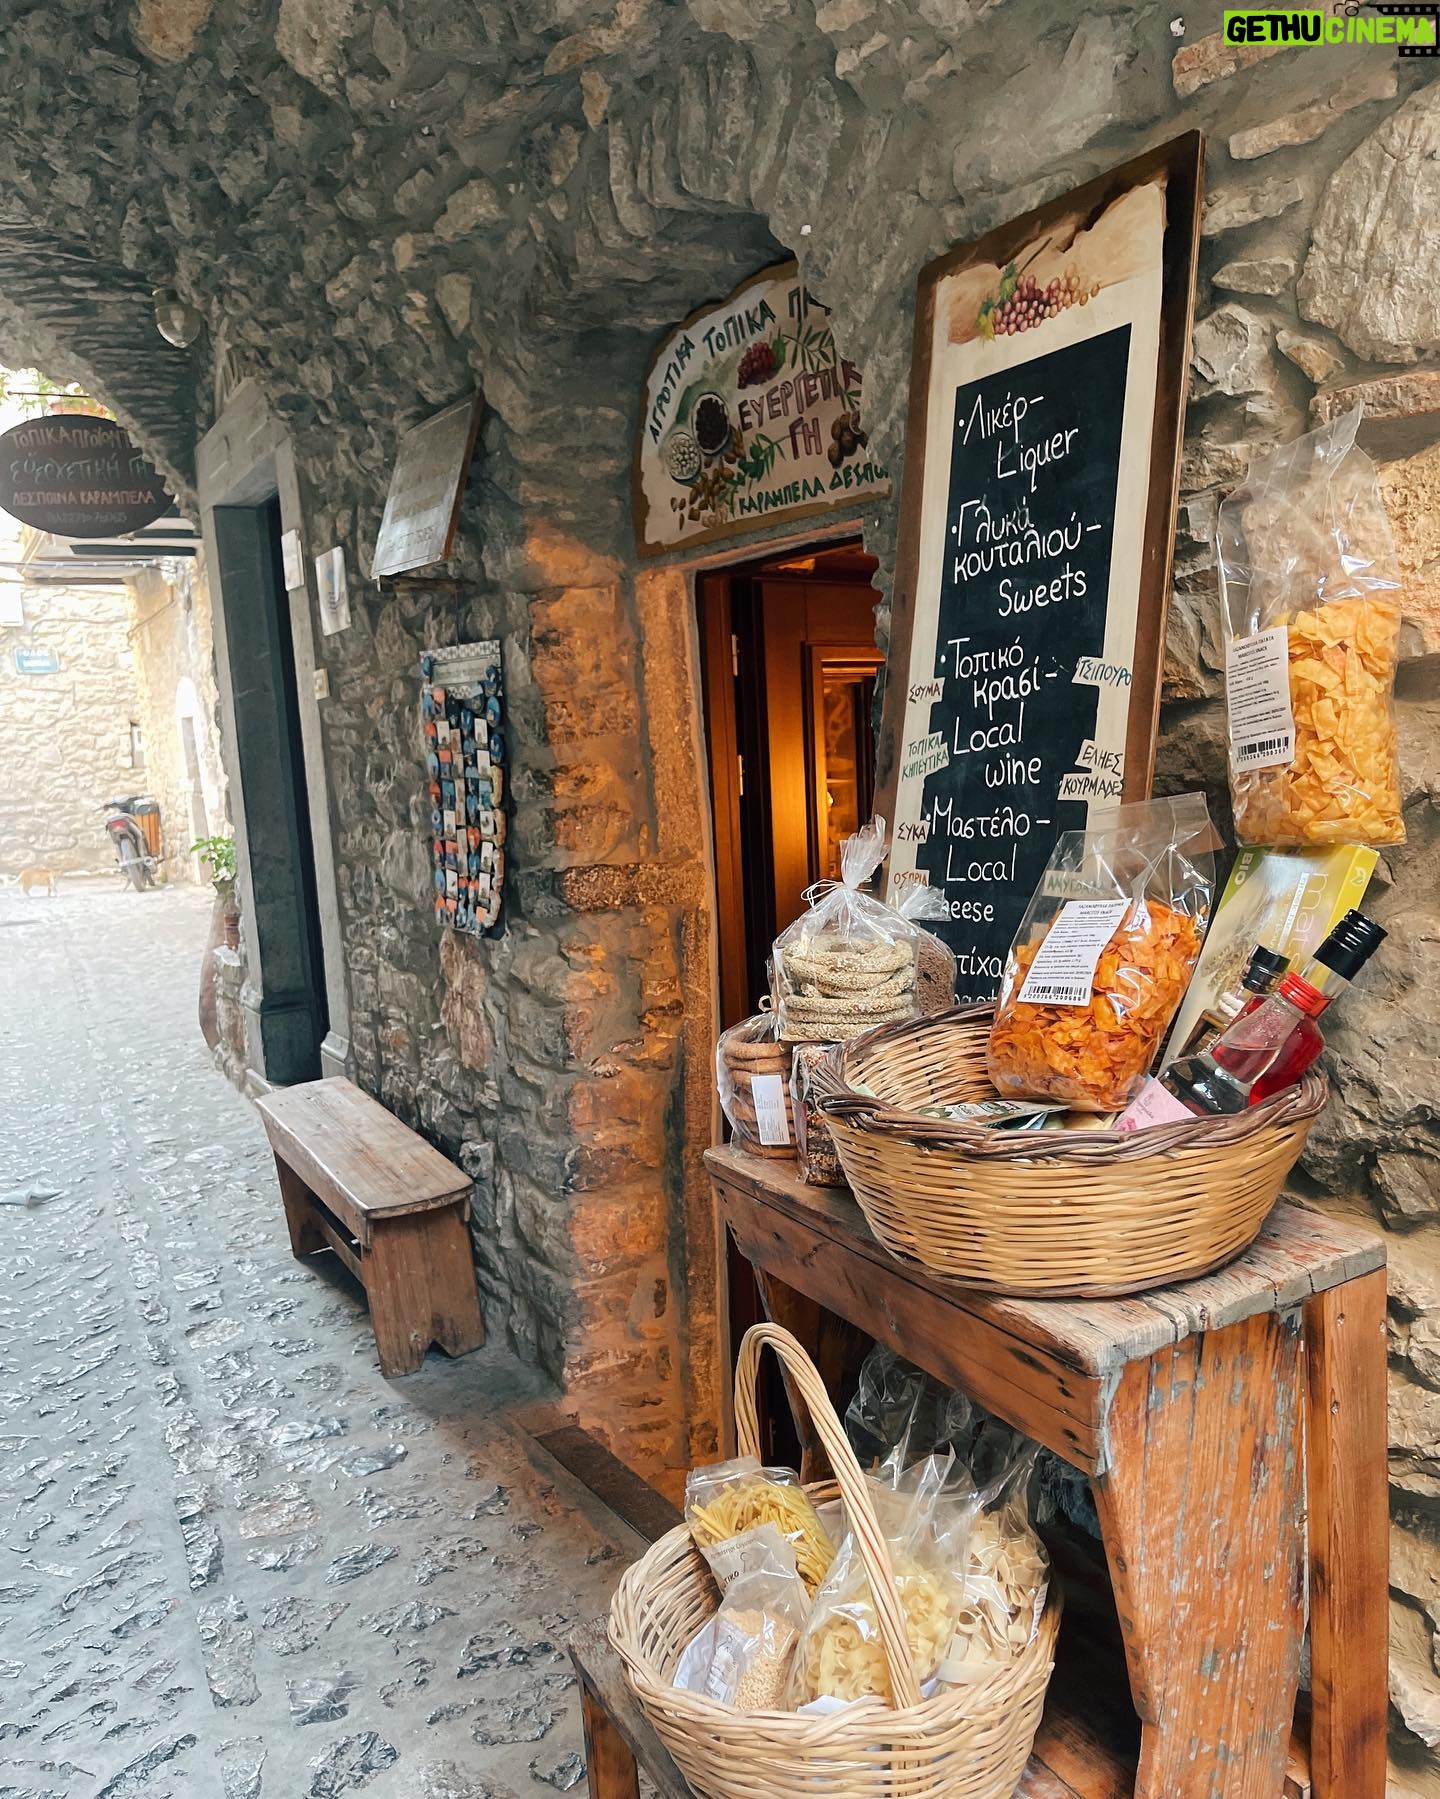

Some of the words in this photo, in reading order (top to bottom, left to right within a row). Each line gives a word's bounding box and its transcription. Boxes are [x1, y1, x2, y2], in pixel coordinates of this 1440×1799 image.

[649, 335, 695, 444] ΑΓΡΟΤΙΚΑ
[737, 360, 863, 432] ΕΥΕΡΓΕΤΙΚ
[789, 416, 821, 460] ΓΗ
[997, 428, 1078, 492] Liquer
[957, 494, 1035, 546] Γλυκά
[998, 562, 1087, 616] Sweets
[948, 636, 1024, 679] Τοπικό
[1078, 659, 1132, 687] ΤΣΙΠΟΥΡΟ
[909, 683, 940, 704] ΣΟΥΜΑ
[953, 702, 1025, 755] Local
[985, 752, 1042, 788] wine
[1062, 775, 1125, 798] ΚΟΥΡΜΑΔΕΣ
[898, 824, 926, 841] ΣΥΚΑ
[946, 843, 1017, 882] Local
[1234, 852, 1254, 886] BIO
[948, 899, 995, 922] eese
